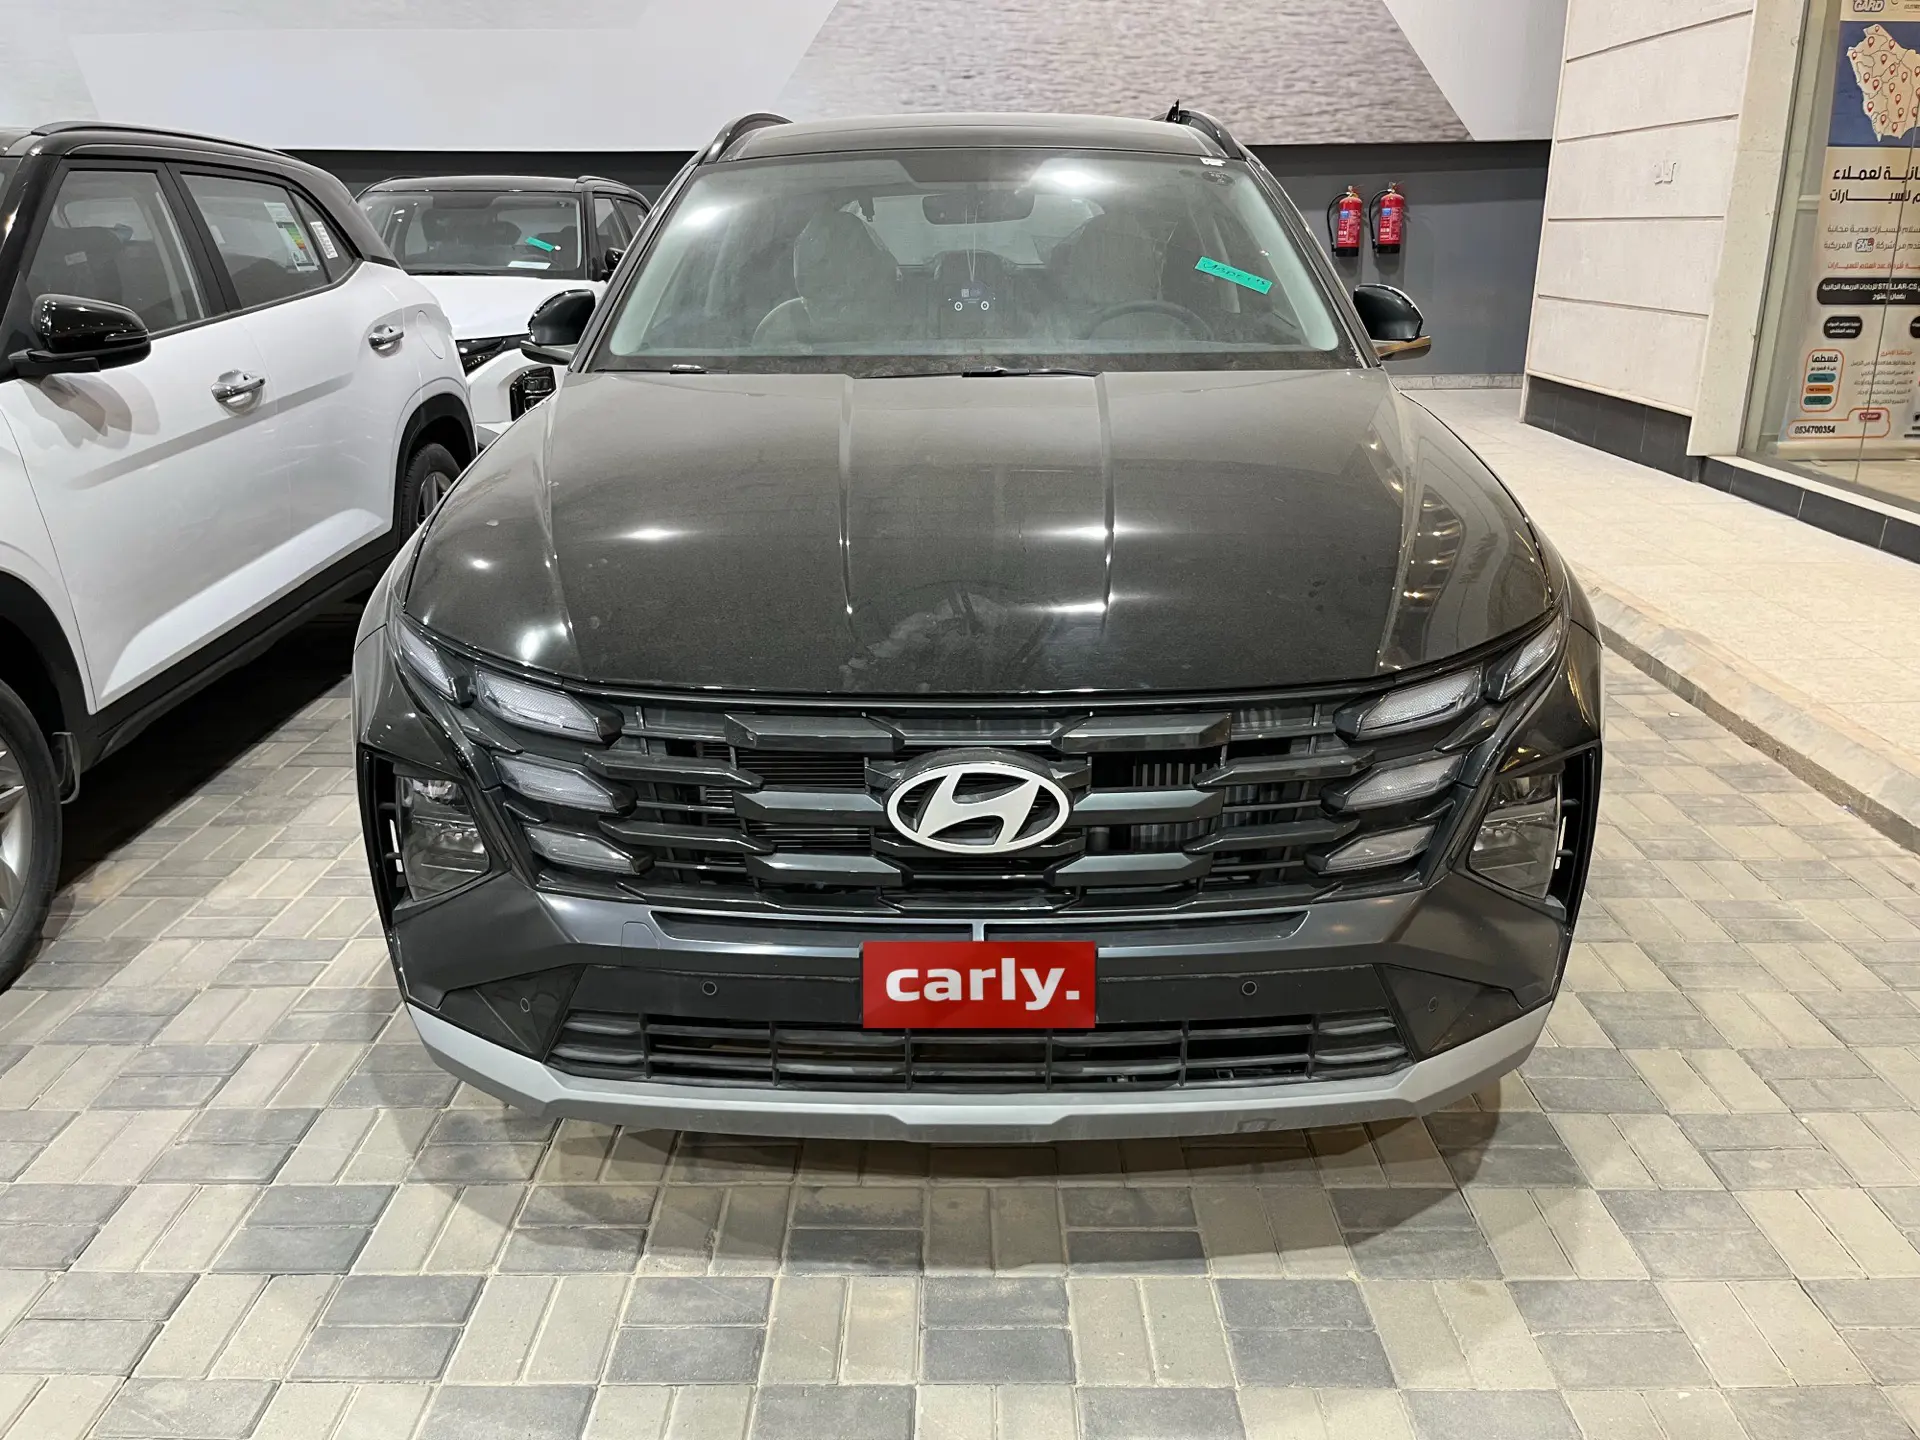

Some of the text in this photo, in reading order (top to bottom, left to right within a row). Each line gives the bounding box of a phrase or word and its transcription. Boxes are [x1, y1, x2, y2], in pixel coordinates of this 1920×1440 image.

[1832, 165, 1920, 183] انية لعملاء
[1794, 426, 1836, 434] 0534700354
[886, 957, 1080, 1011] carly.
